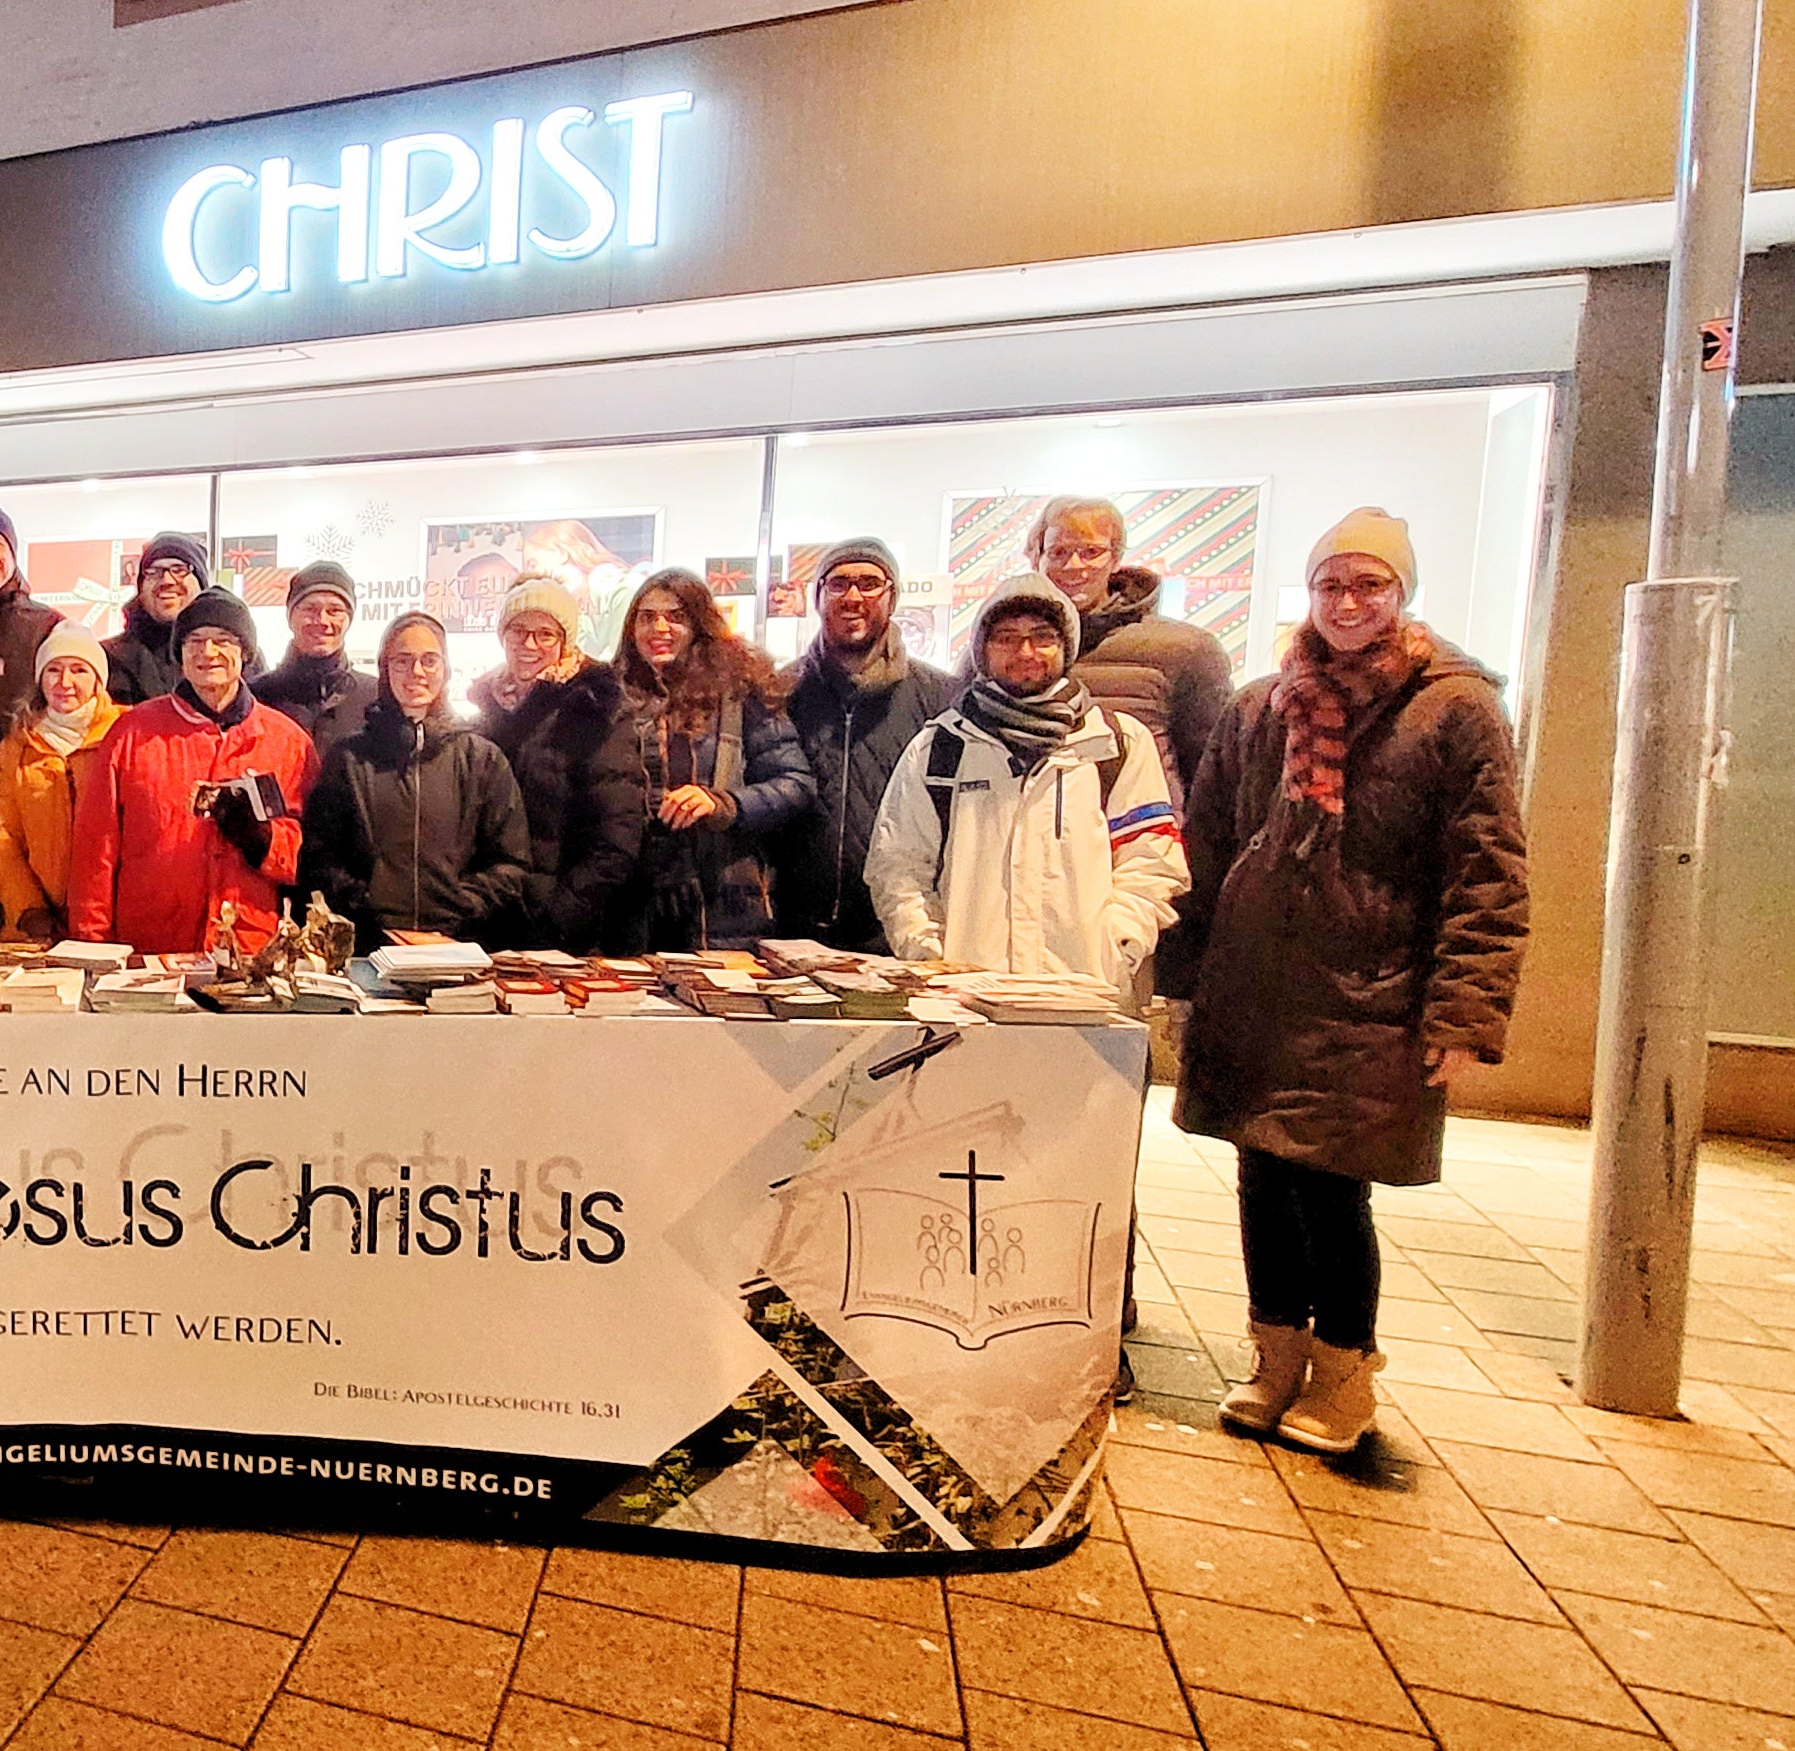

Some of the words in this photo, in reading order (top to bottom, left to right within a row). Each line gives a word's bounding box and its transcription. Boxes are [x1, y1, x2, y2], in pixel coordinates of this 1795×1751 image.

[161, 90, 695, 304] CHRIST
[354, 575, 470, 600] CHMÜCKT
[361, 602, 403, 622] MIT
[21, 1068, 71, 1097] AN
[87, 1069, 161, 1097] DEN
[178, 1064, 308, 1099] HERRN
[209, 1160, 626, 1265] Christus
[175, 1313, 343, 1347] WERDEN.
[314, 1381, 340, 1399] DIE
[347, 1384, 398, 1402] BIBEL:
[402, 1389, 573, 1416] APOSTELGESCHICHTE
